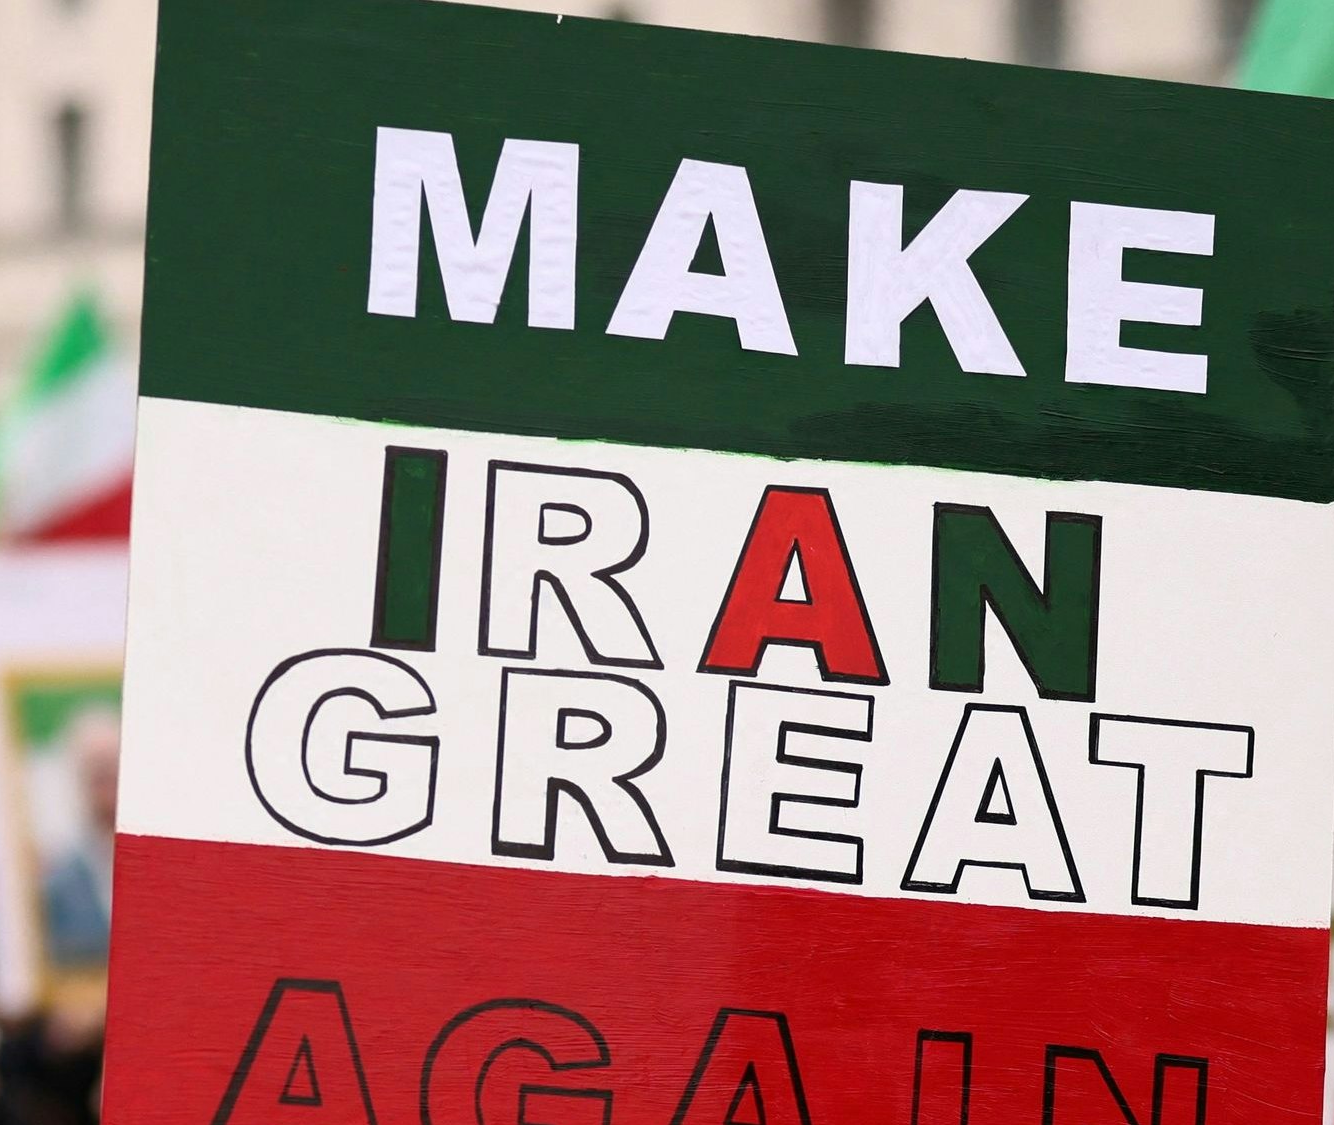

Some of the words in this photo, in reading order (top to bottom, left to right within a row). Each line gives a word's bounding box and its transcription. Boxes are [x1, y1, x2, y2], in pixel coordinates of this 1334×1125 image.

[366, 125, 1216, 394] MAKE
[369, 444, 1104, 702] IRAN
[244, 646, 1255, 910] GREAT
